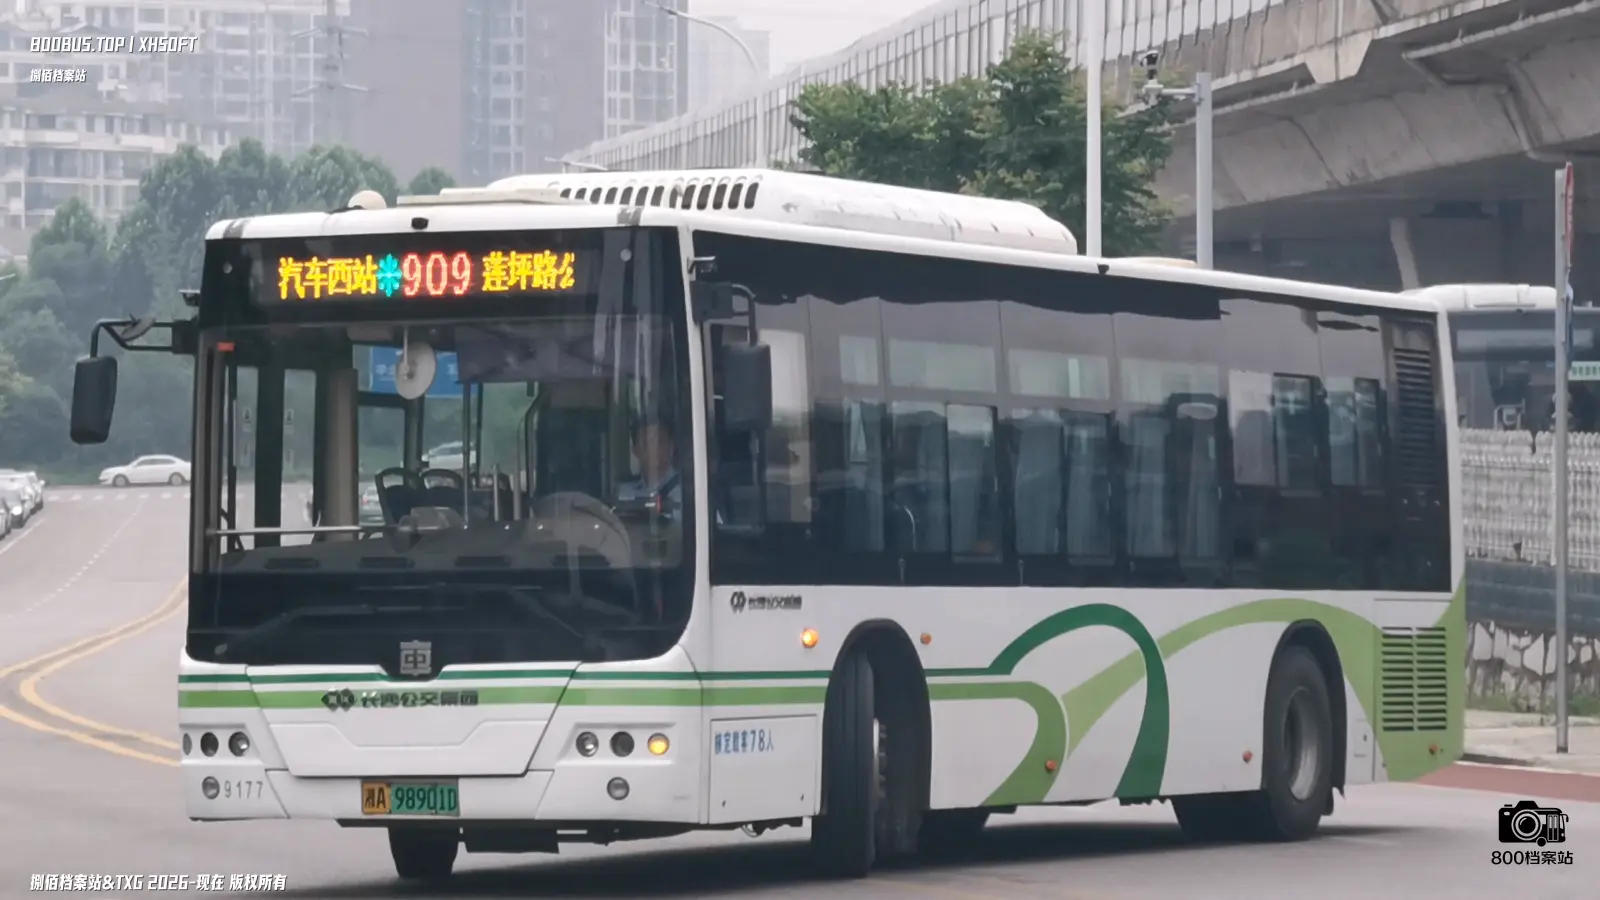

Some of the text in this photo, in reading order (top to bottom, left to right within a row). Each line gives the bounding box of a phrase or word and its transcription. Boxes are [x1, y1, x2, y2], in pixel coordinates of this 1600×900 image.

[279, 255, 377, 299] 汽车西站
[403, 252, 472, 296] 909
[224, 781, 264, 798] 9177
